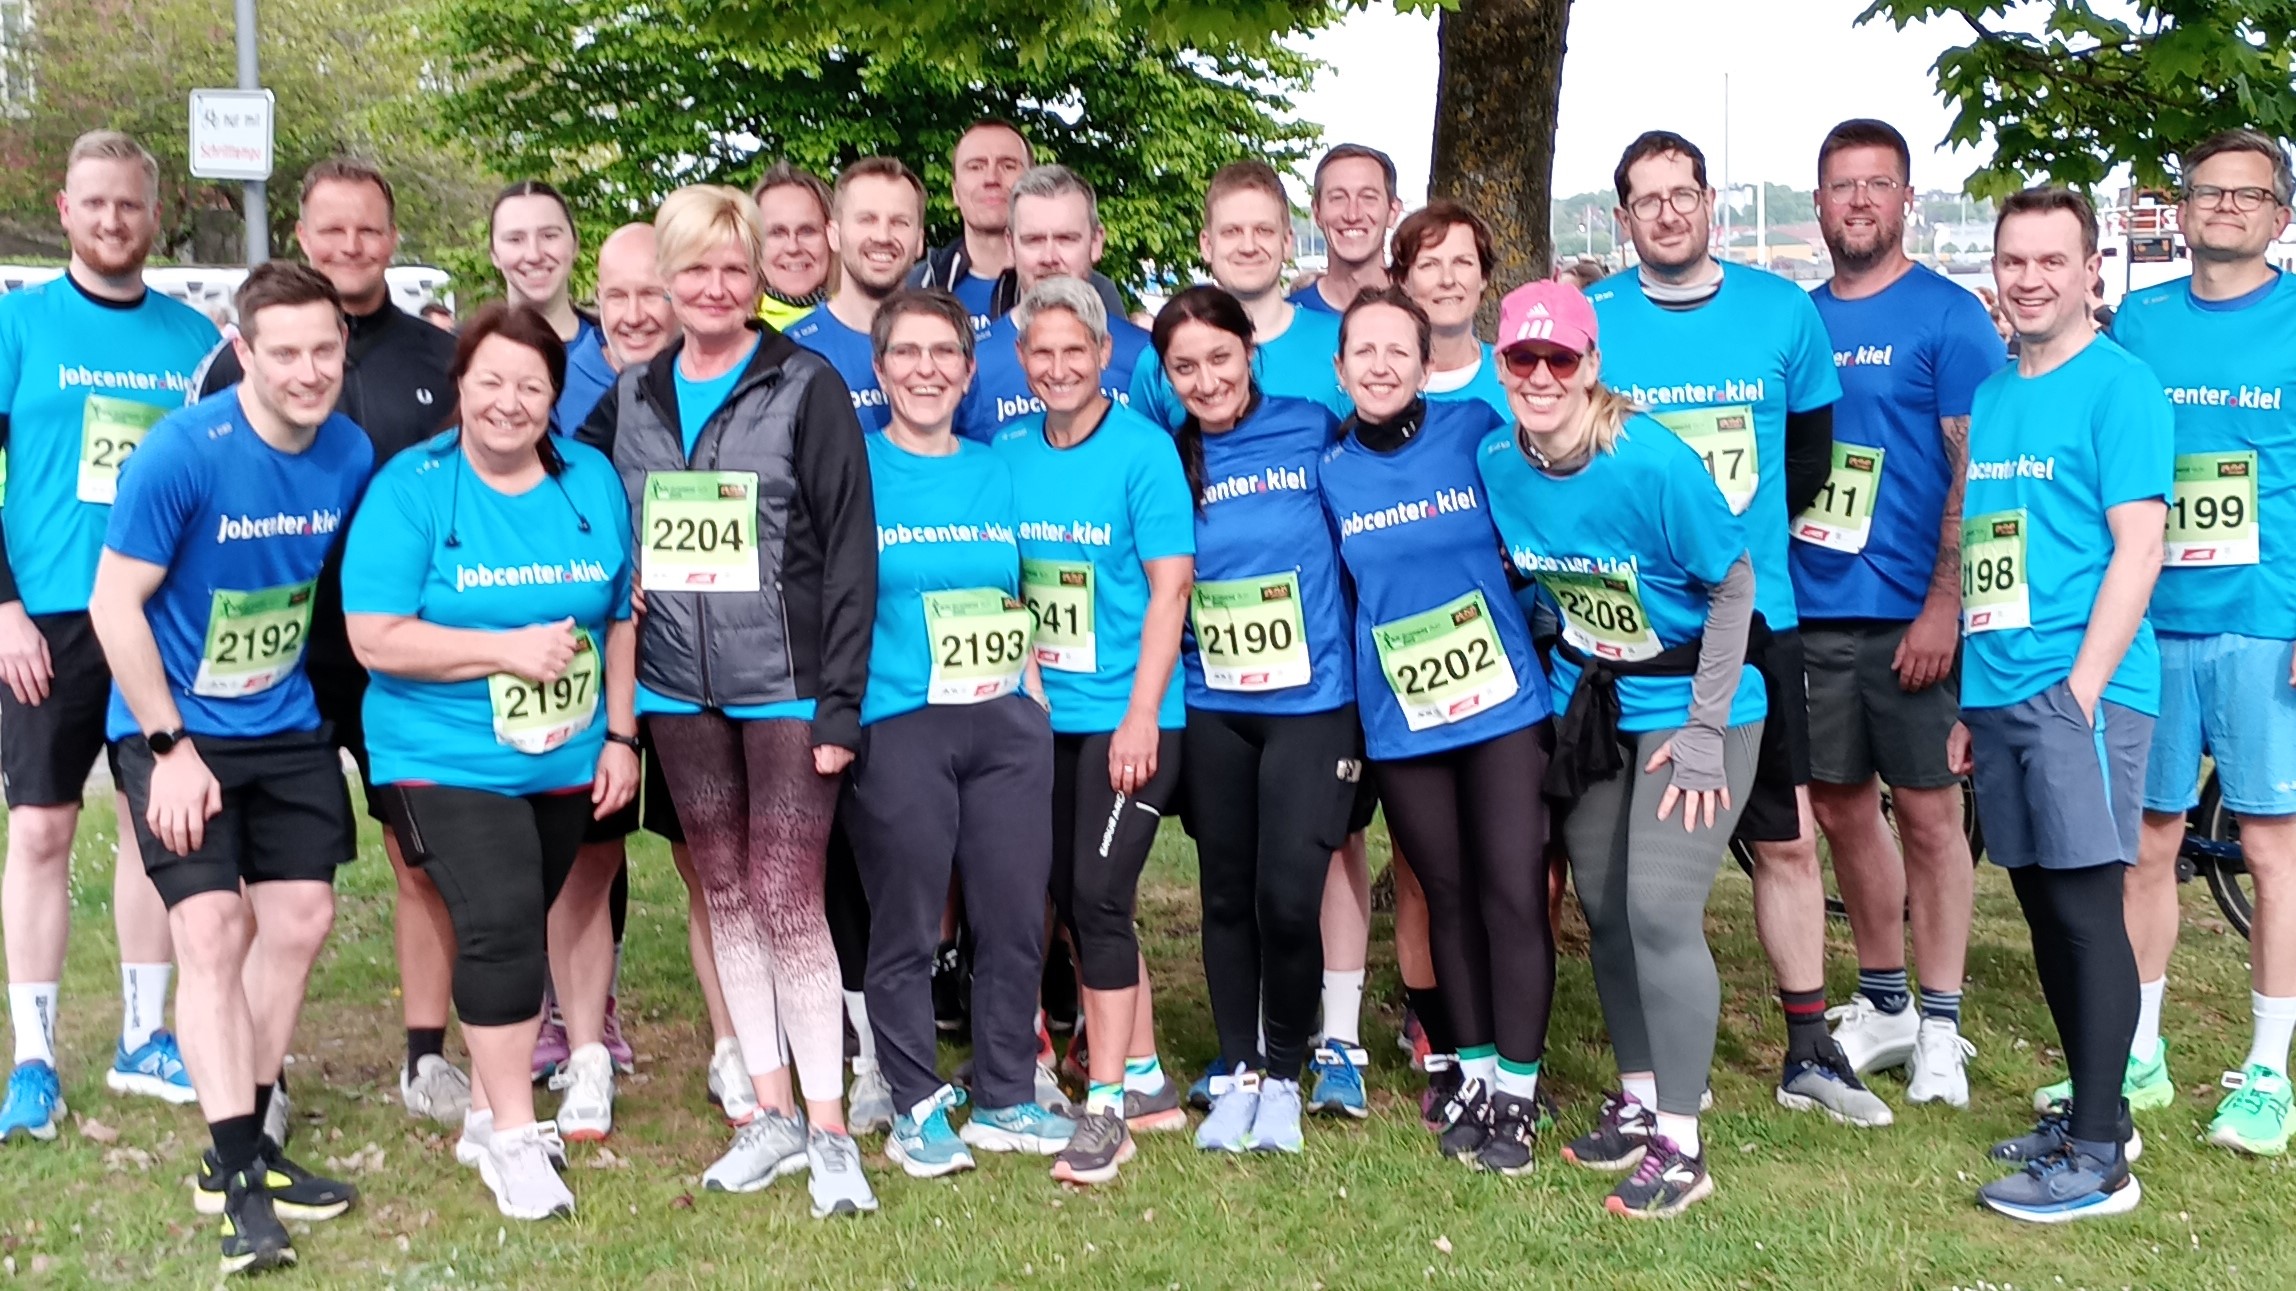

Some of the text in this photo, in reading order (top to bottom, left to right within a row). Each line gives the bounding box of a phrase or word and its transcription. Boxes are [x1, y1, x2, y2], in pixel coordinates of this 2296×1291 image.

[653, 518, 744, 552] 2204
[1560, 590, 1639, 634] 2208
[215, 619, 302, 665] 2192
[941, 629, 1025, 668] 2193
[1203, 618, 1292, 656] 2190
[1397, 638, 1496, 696] 2202
[504, 668, 592, 719] 2197
